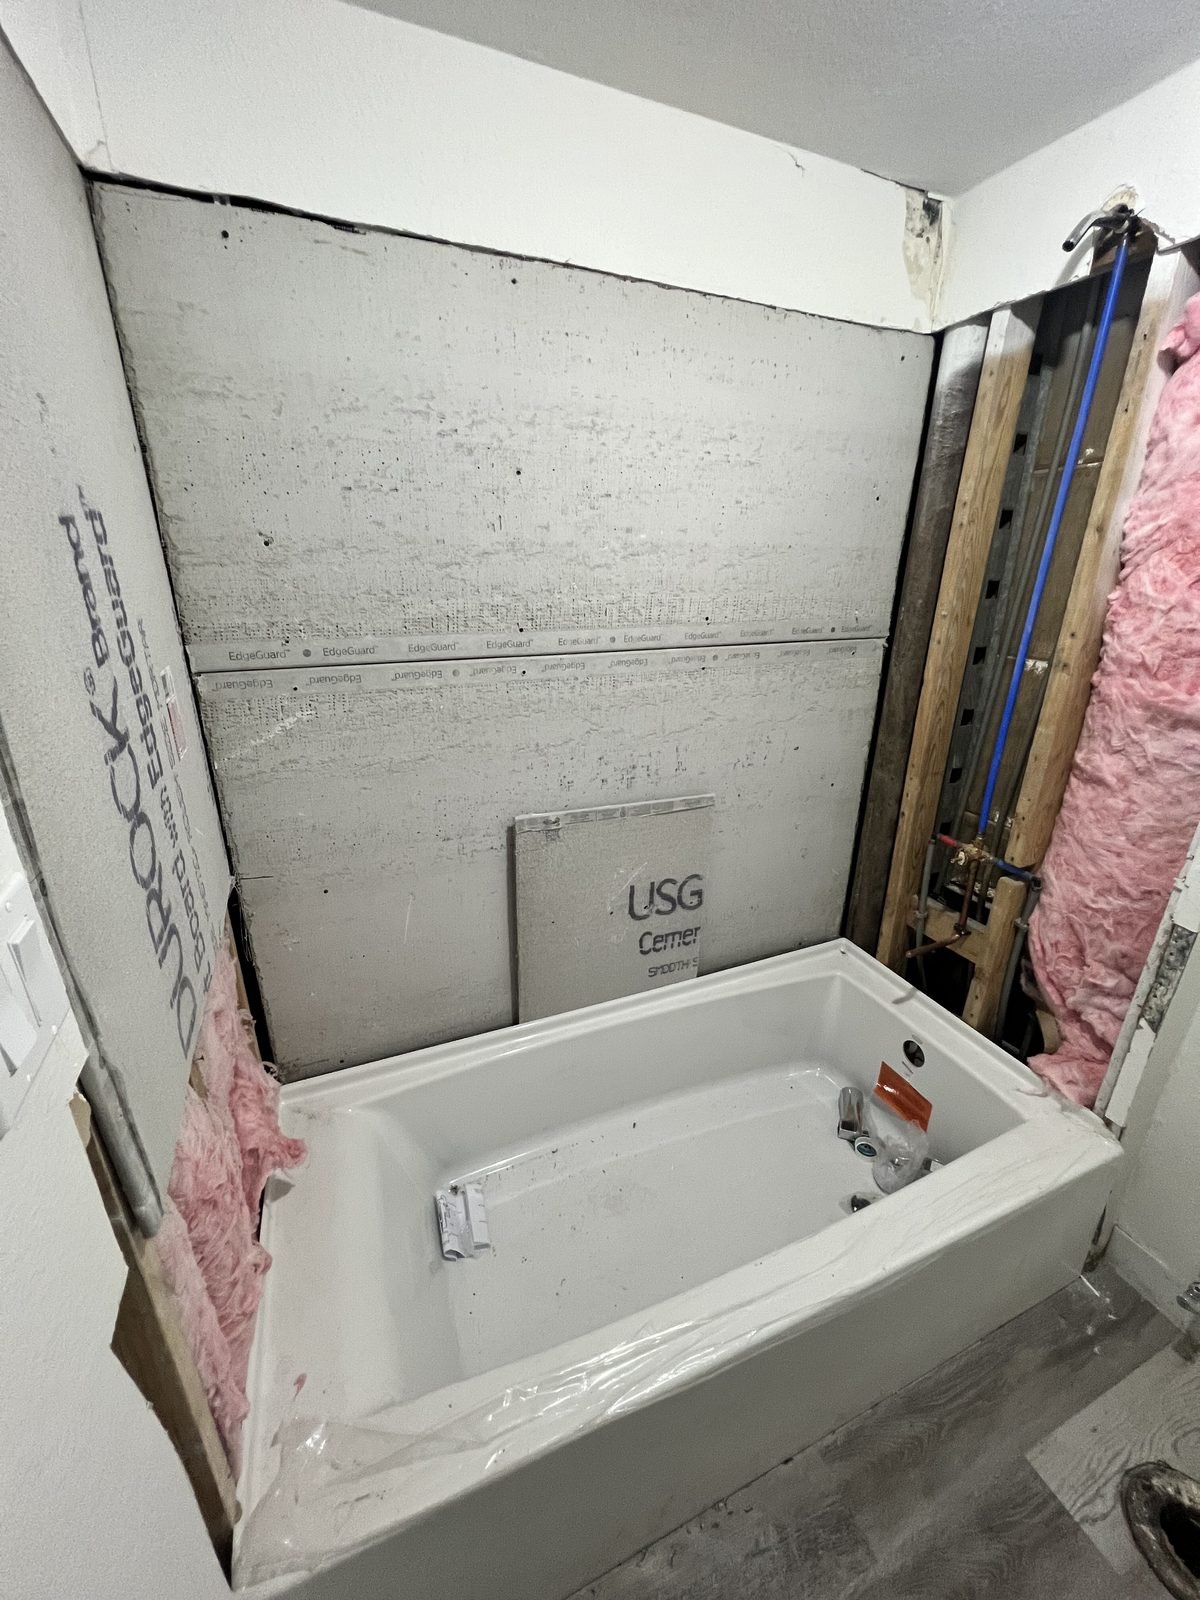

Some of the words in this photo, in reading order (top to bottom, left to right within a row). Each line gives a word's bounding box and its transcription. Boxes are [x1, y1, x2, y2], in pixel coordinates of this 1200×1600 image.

[58, 515, 110, 668] Brand
[160, 784, 178, 848] with
[172, 848, 206, 974] Board
[628, 873, 703, 921] USG
